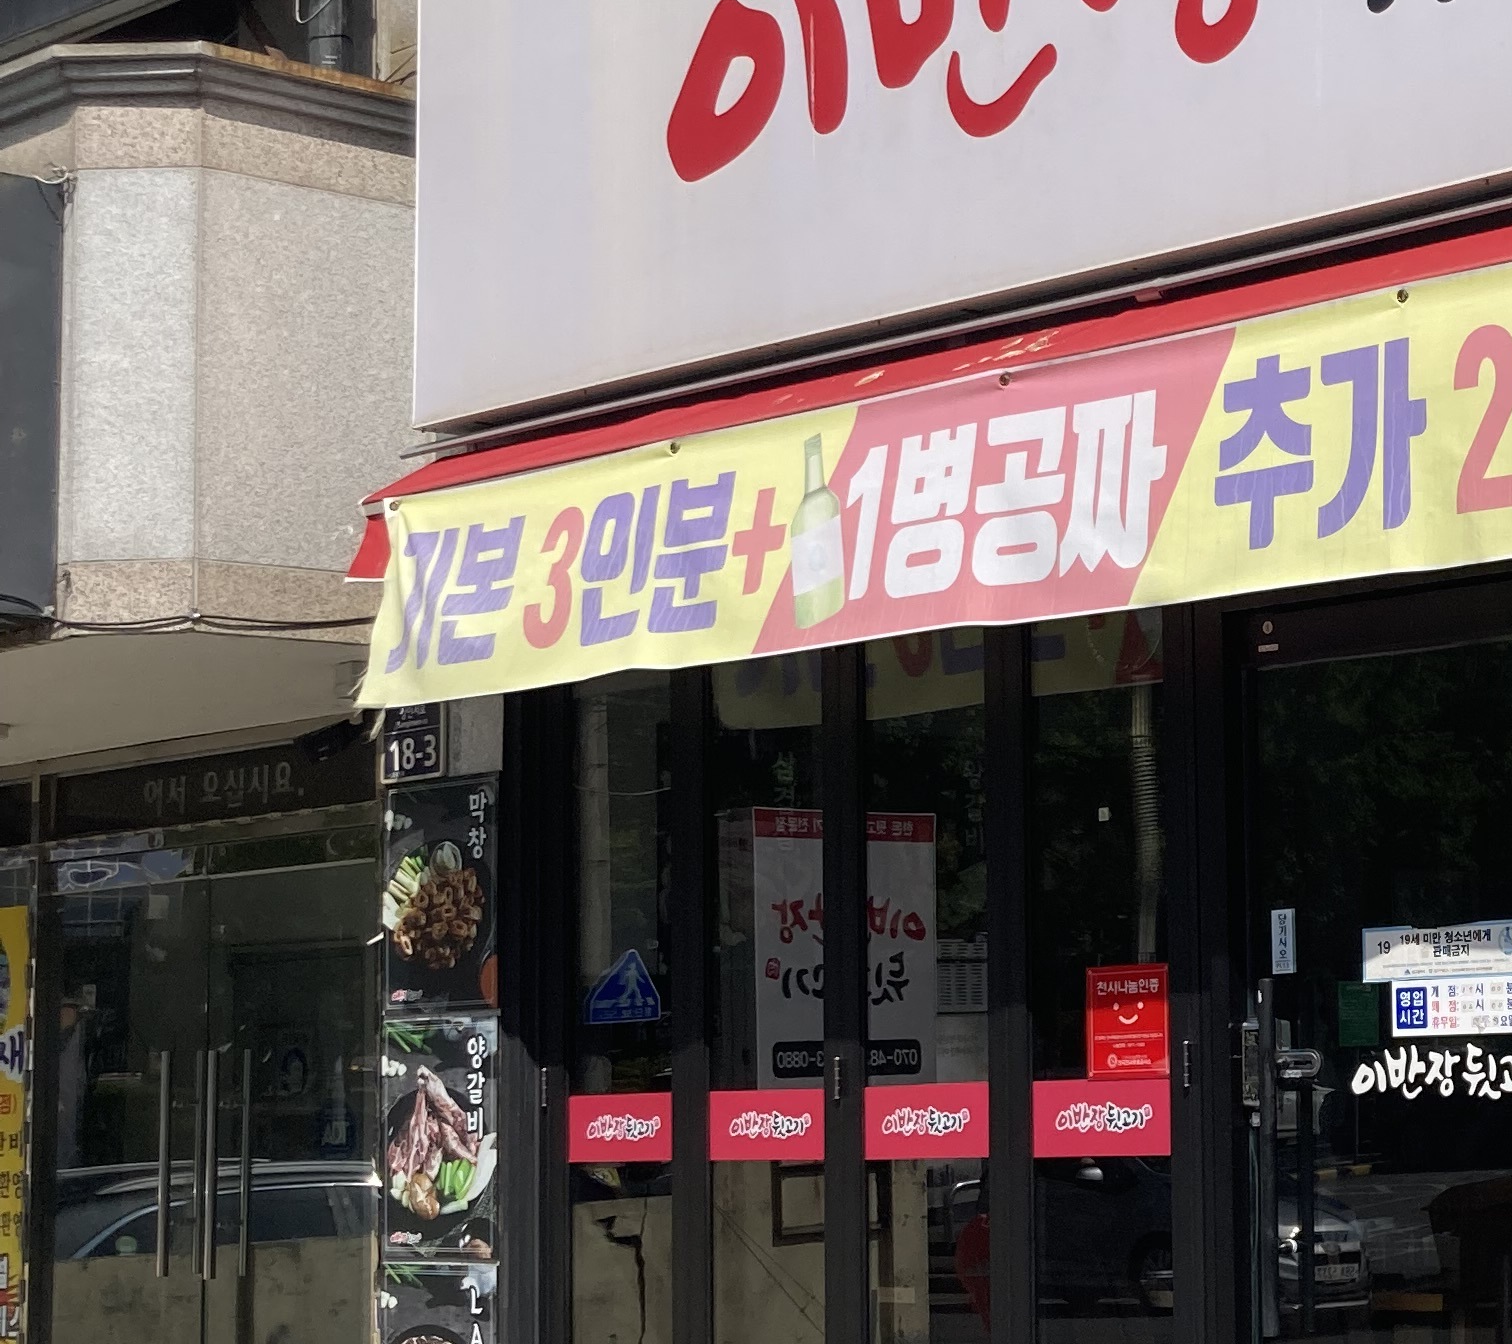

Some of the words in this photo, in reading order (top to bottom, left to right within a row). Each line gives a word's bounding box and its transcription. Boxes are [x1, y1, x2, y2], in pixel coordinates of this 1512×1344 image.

[386, 514, 526, 675] 기본
[846, 388, 1167, 603] 1병공짜
[1214, 338, 1427, 550] 추가
[390, 734, 437, 771] 18-3
[468, 792, 488, 859] 막창
[1278, 913, 1287, 959] 당기시오
[1377, 940, 1391, 954] 19
[1400, 933, 1420, 945] 19세
[1423, 932, 1441, 944] 미만
[1444, 928, 1492, 943] 청소년에게
[1433, 945, 1470, 958] 판매금지
[1400, 991, 1424, 1007] 영업
[1400, 1009, 1425, 1025] 시간
[1351, 1044, 1461, 1099] 이반장
[466, 1036, 486, 1141] 양갈비
[587, 1114, 625, 1141] 이반장
[625, 1114, 655, 1141] 뒷고기
[729, 1111, 772, 1139] 이반장
[772, 1111, 805, 1139] 뒷고기
[882, 1107, 927, 1136] 이반장
[927, 1106, 963, 1136] 뒷고기
[1055, 1102, 1105, 1133] 이반장
[1105, 1102, 1145, 1133] 뒷고기
